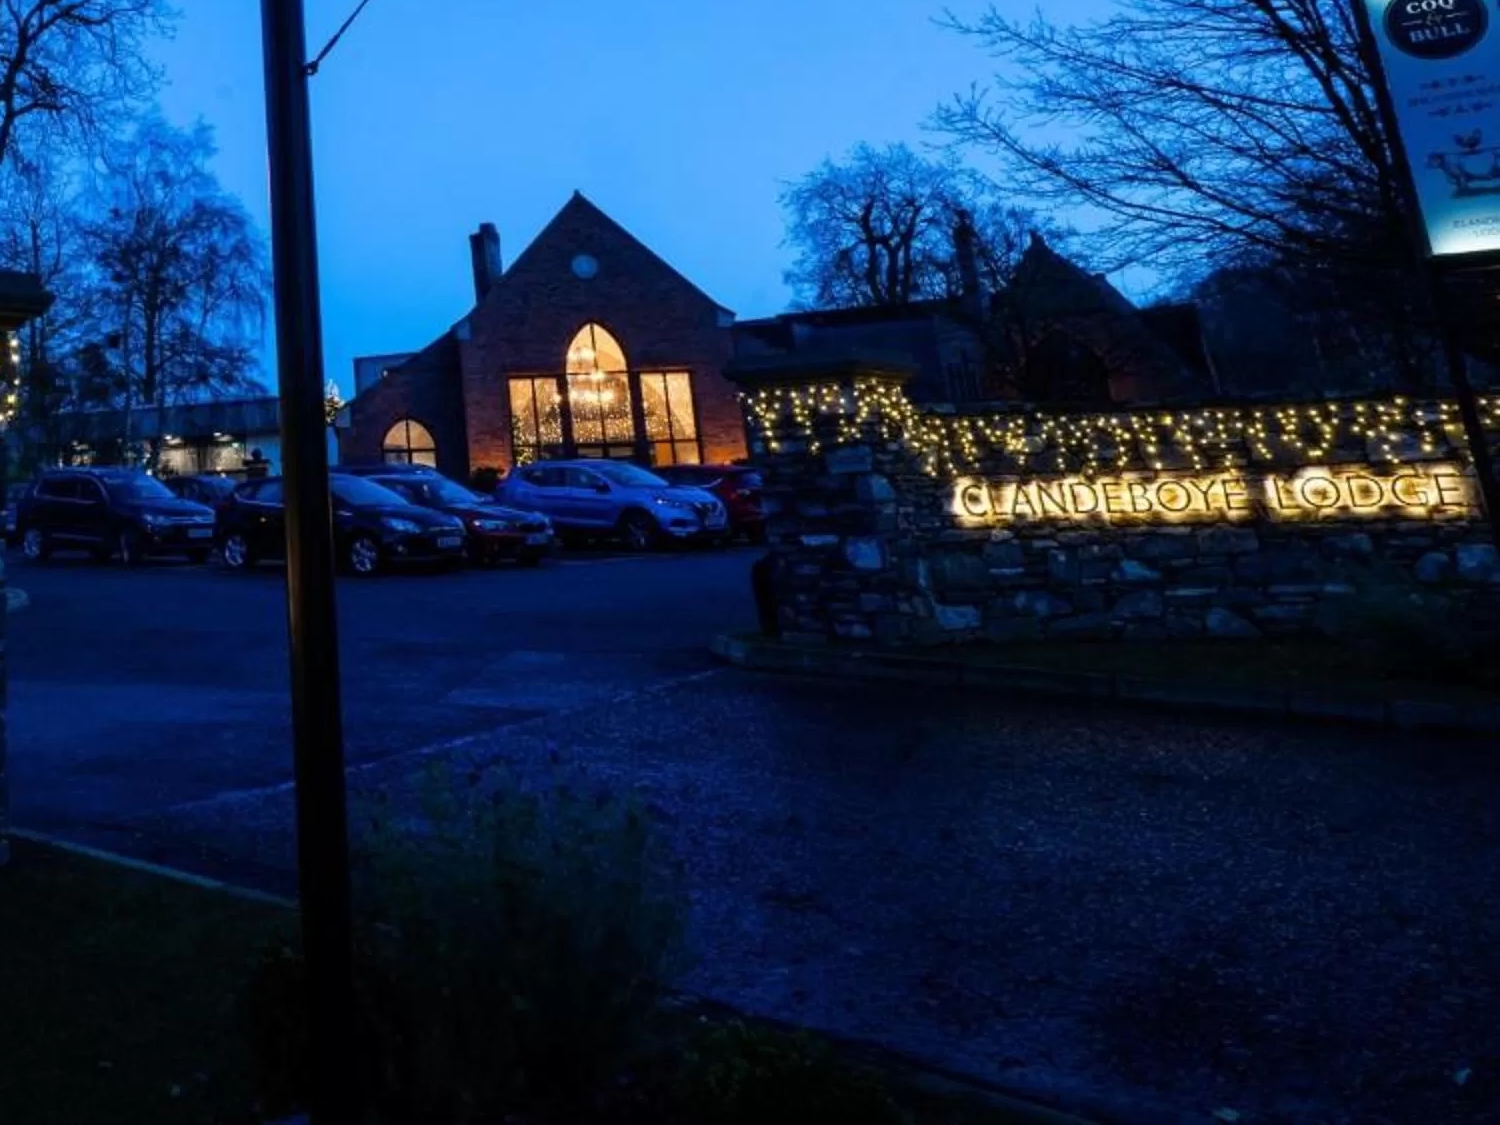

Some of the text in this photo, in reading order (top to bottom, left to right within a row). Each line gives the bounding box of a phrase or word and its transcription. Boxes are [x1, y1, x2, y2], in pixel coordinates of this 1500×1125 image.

[1410, 22, 1471, 43] BULL
[961, 472, 1466, 517] CLANDEBOYE LODGE
